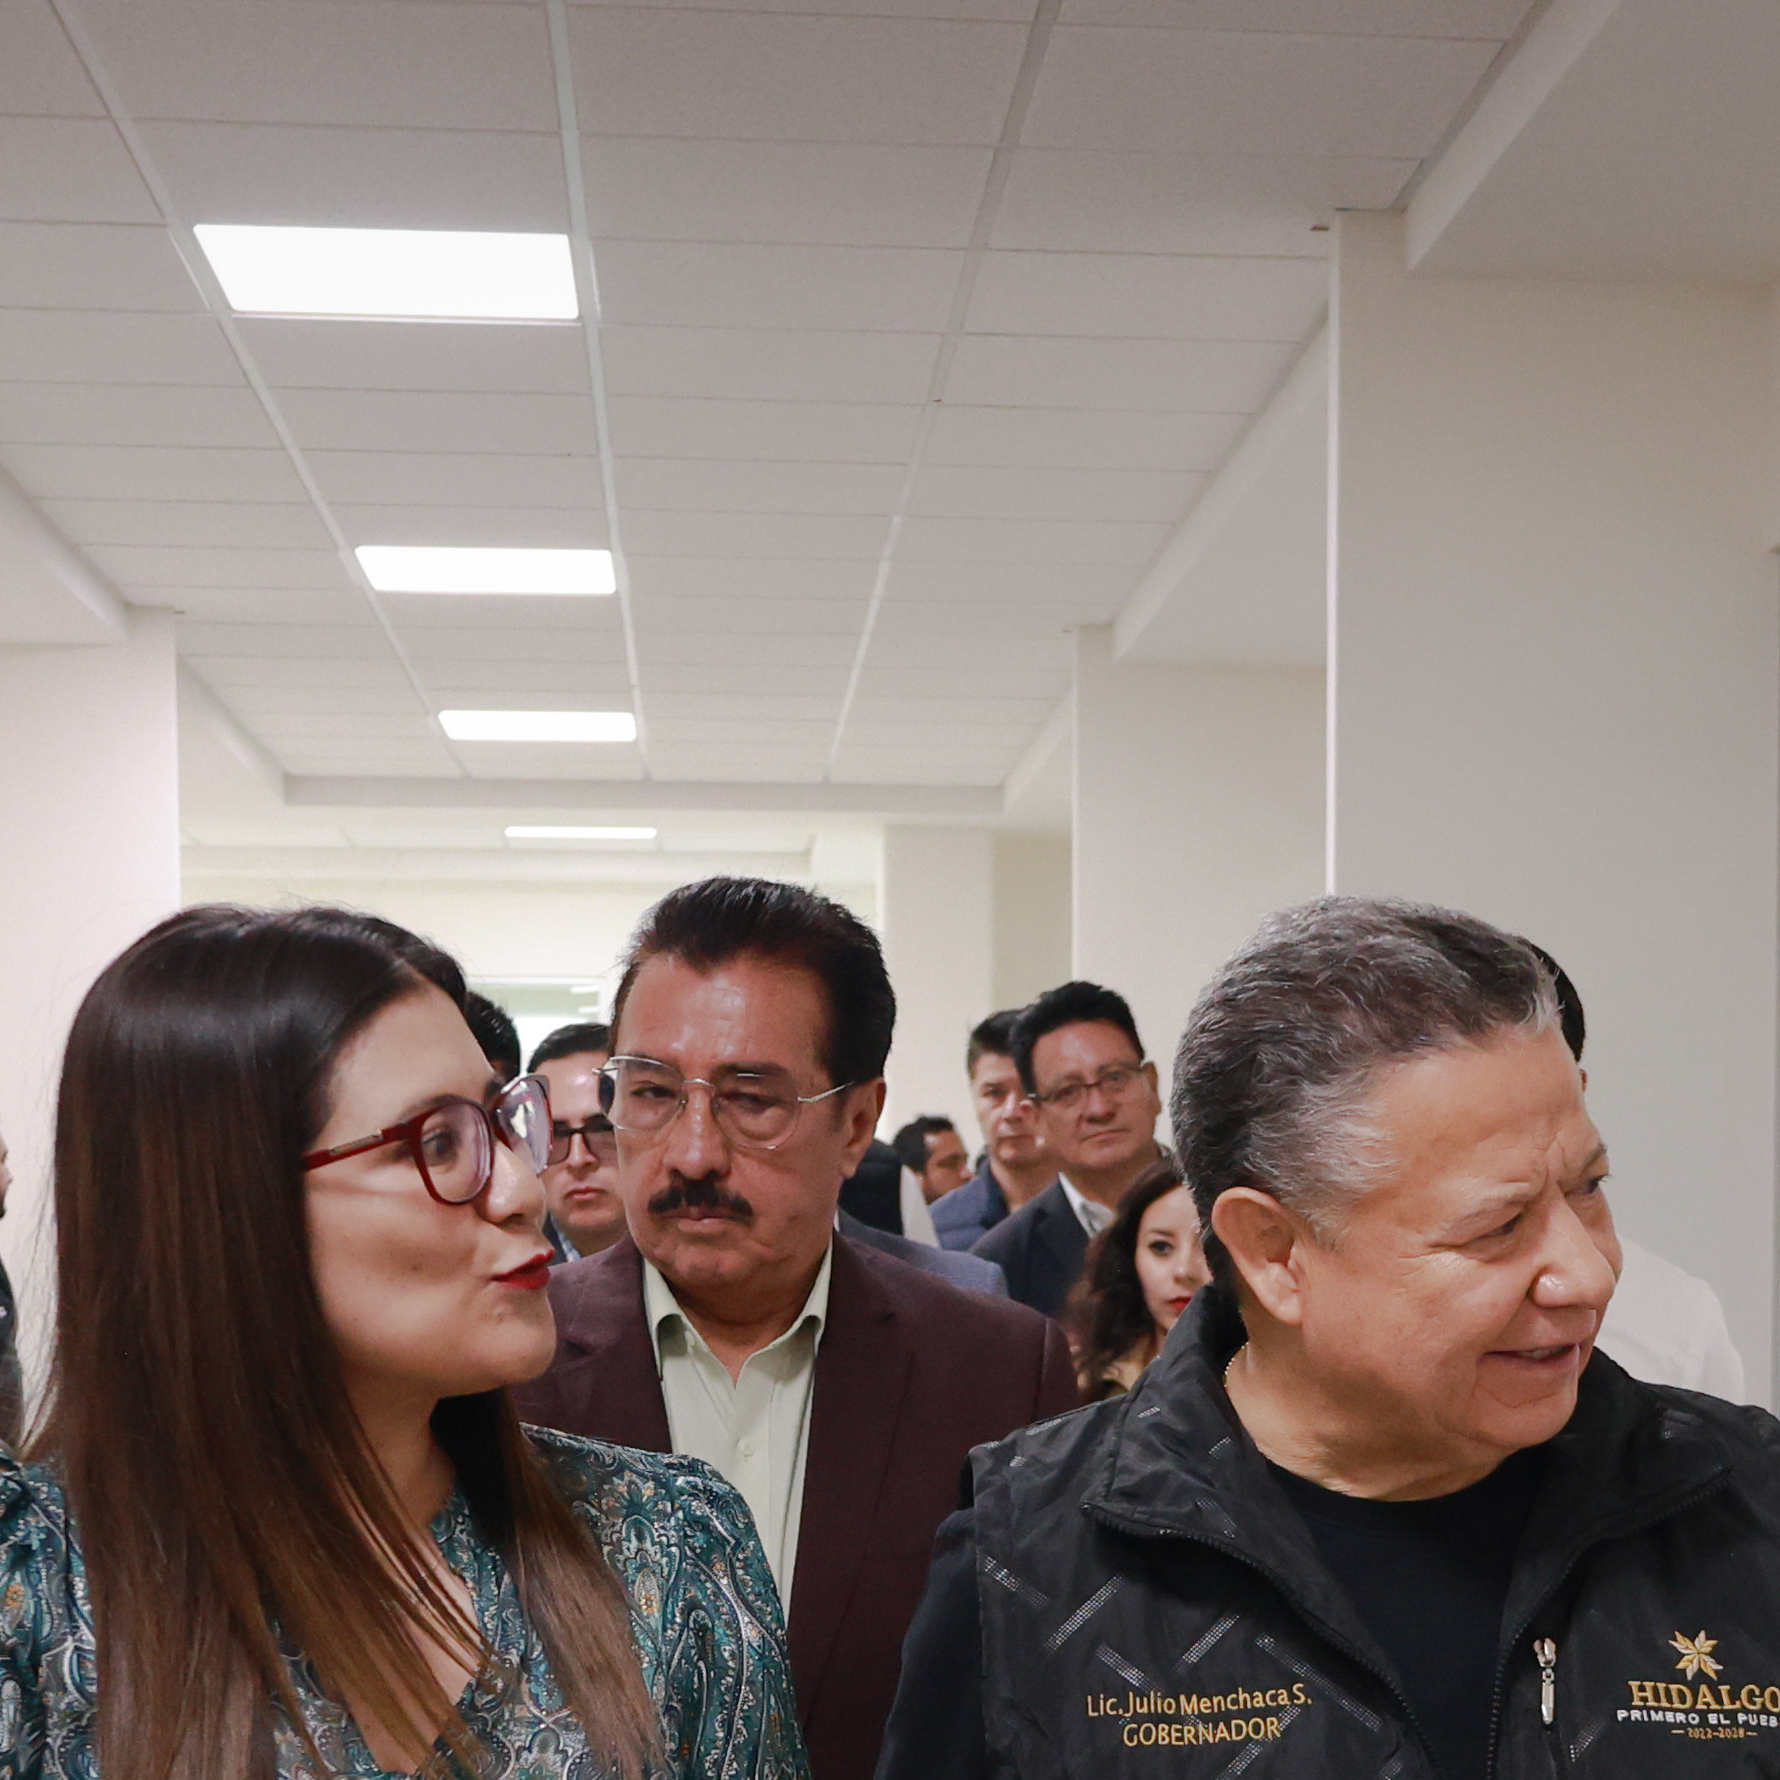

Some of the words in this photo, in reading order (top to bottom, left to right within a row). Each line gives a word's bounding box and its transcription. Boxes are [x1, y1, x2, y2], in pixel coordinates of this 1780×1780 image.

[1123, 1690, 1176, 1717] Julio
[1179, 1687, 1291, 1715] Menchaca
[1292, 1683, 1313, 1705] S.
[1123, 1717, 1281, 1747] GOBERNADOR
[1616, 1709, 1700, 1725] PRIMERO
[1708, 1713, 1731, 1725] EL
